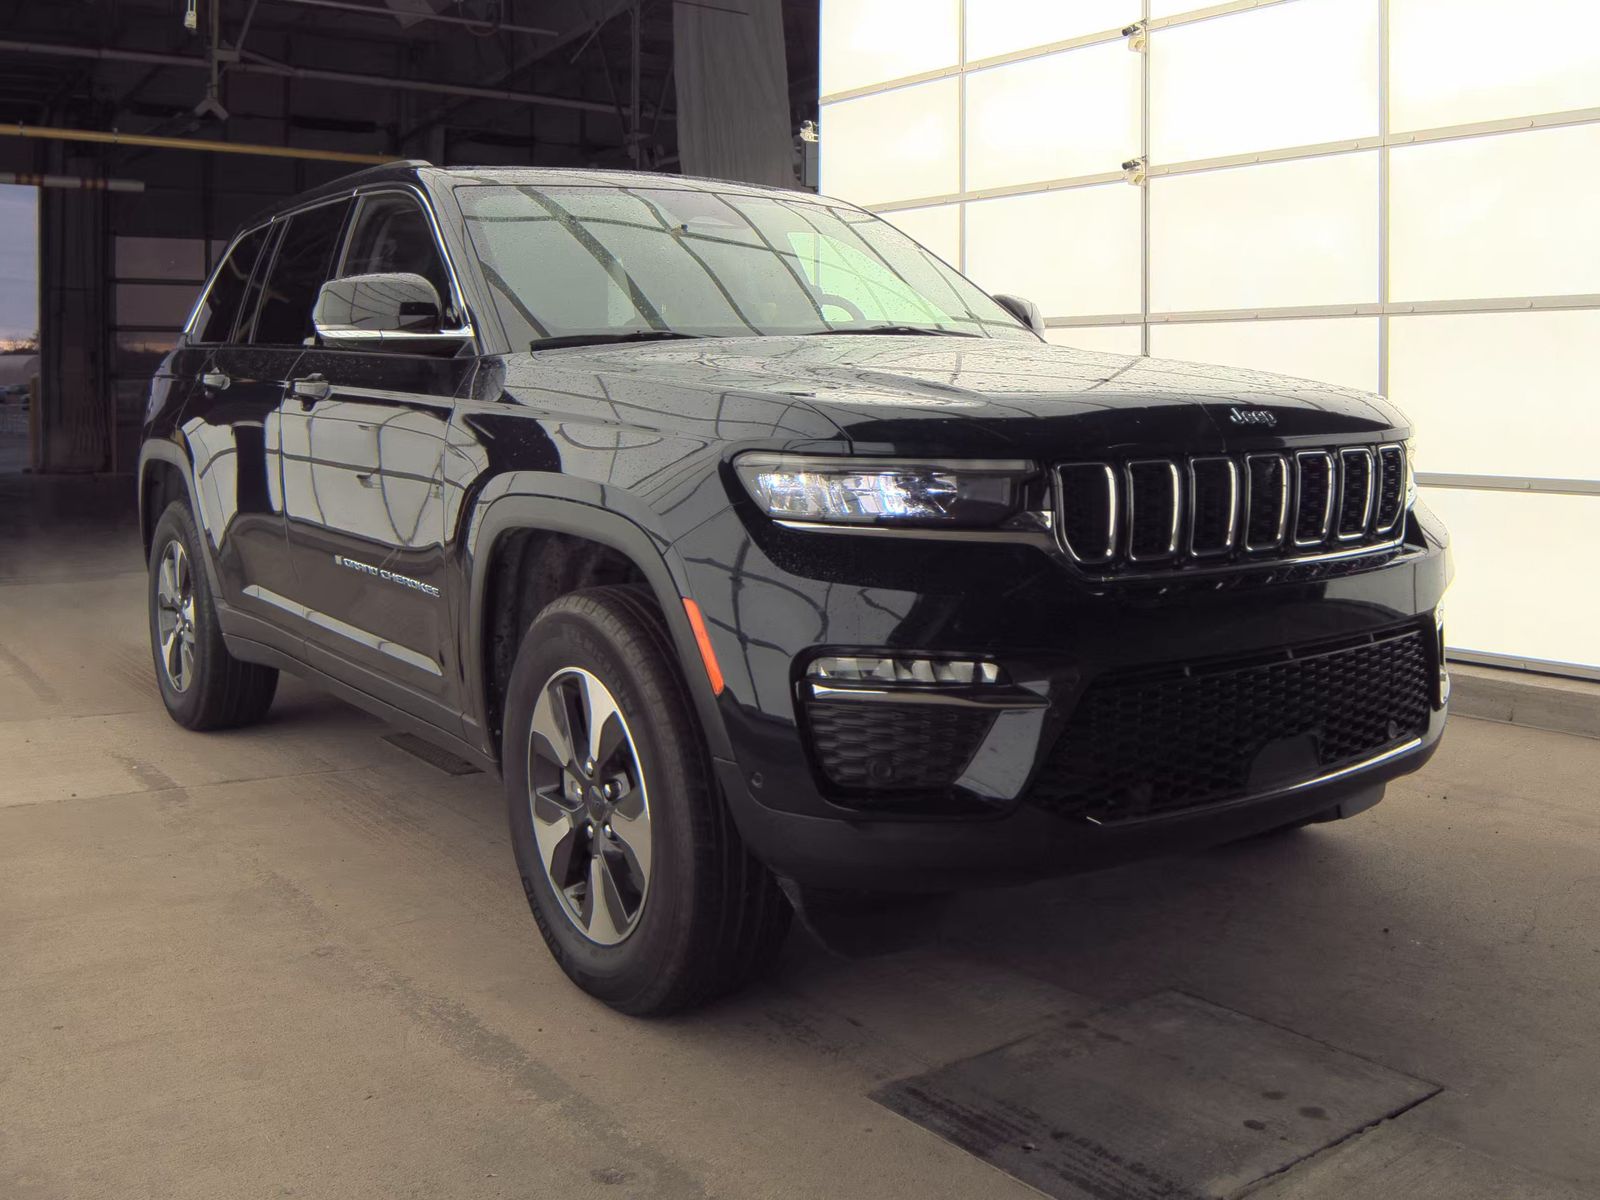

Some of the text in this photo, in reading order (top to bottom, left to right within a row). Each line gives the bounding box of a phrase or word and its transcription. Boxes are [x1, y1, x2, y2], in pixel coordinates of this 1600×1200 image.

[1230, 407, 1277, 427] Jeep
[343, 558, 440, 598] GRAND CHEROKEE
